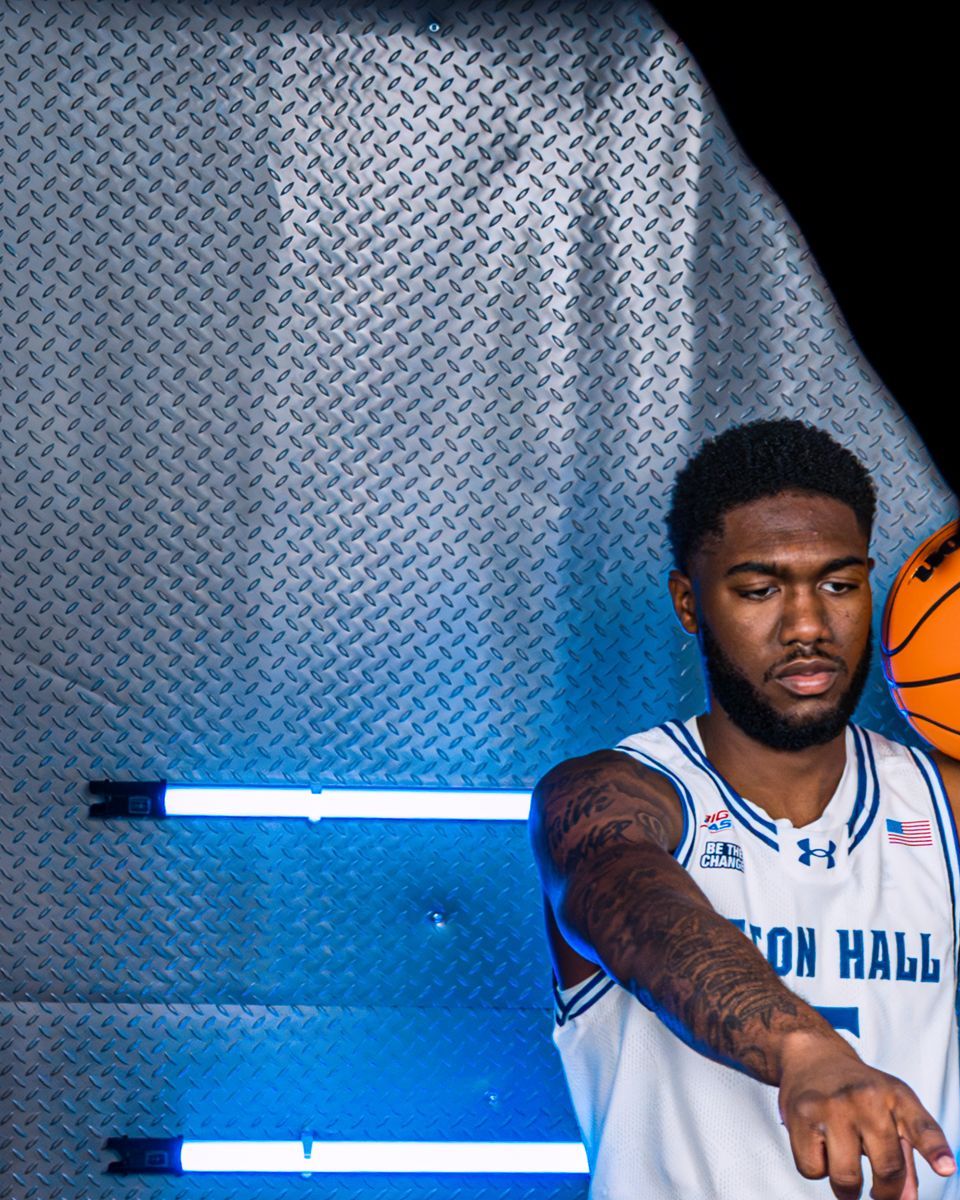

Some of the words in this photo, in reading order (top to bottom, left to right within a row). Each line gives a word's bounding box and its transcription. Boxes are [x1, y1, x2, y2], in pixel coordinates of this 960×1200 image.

[706, 842, 724, 855] BE
[726, 843, 744, 858] TH
[701, 855, 745, 870] CHANG
[728, 918, 817, 978] TON
[835, 928, 941, 983] HALL
